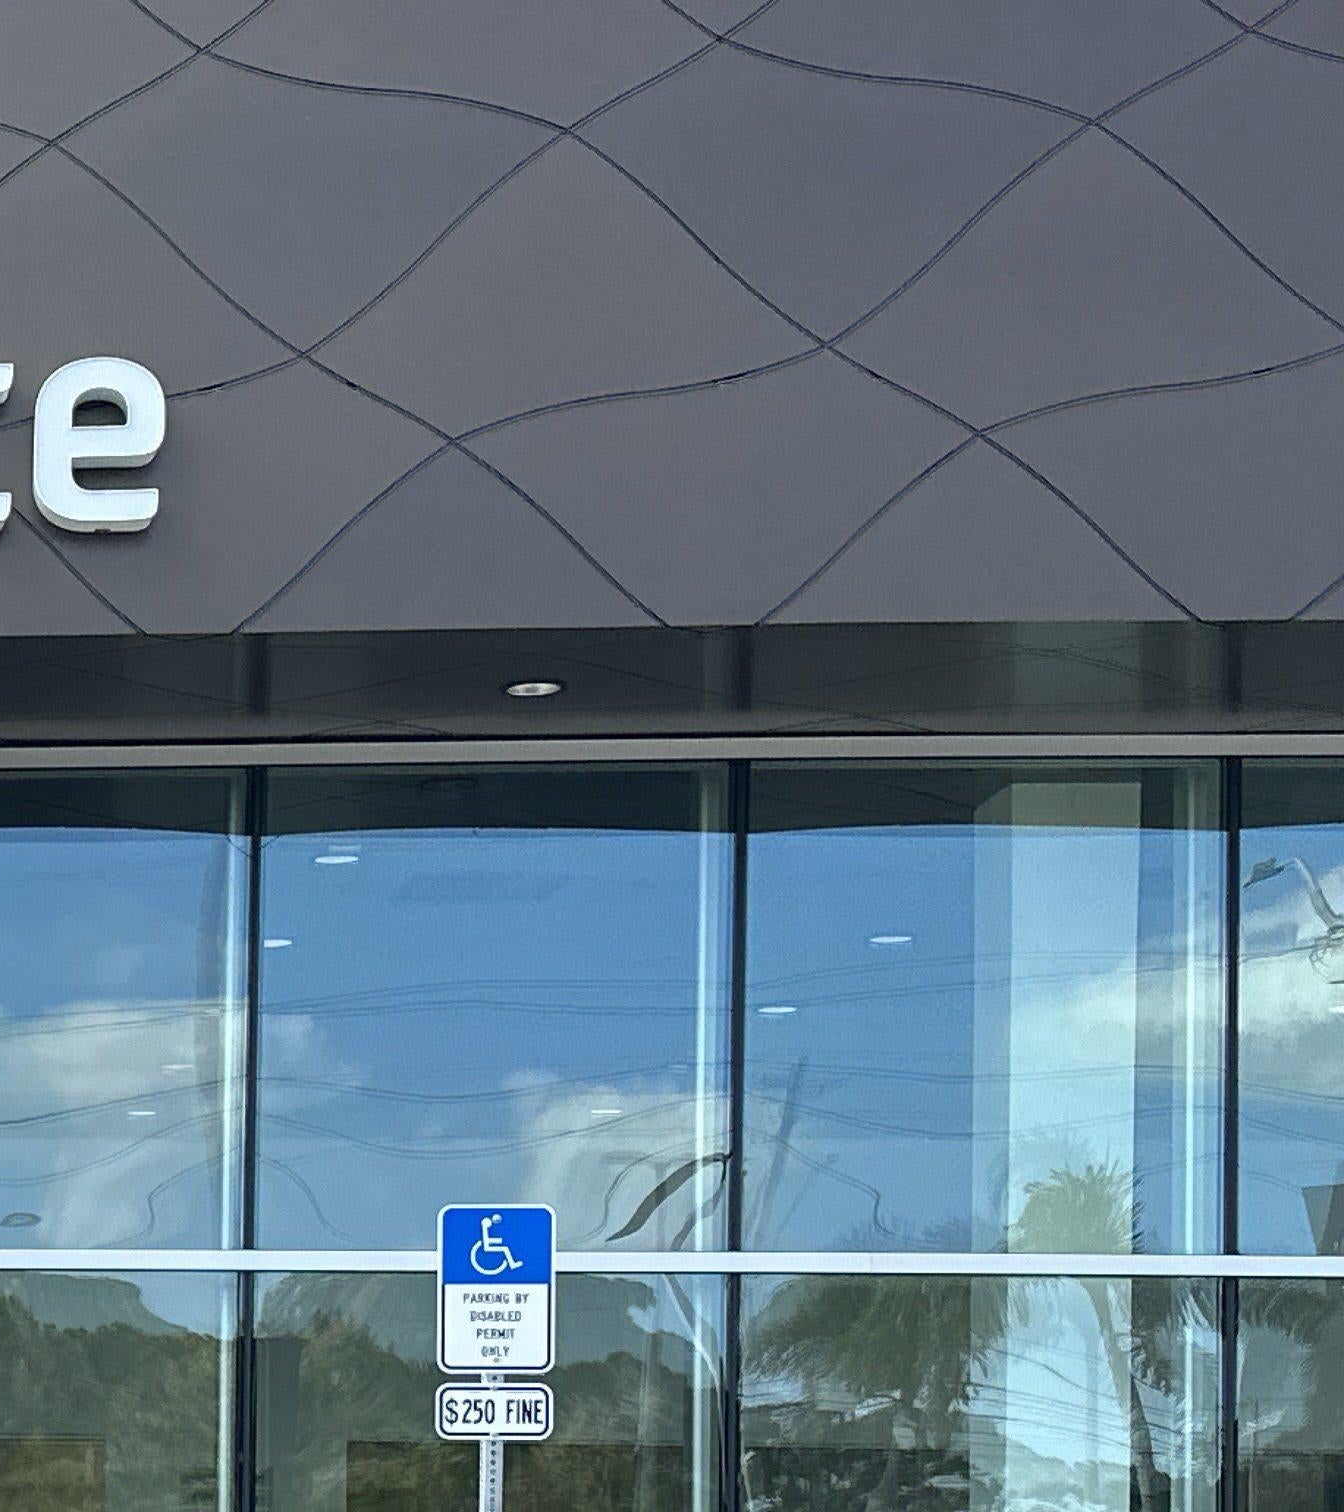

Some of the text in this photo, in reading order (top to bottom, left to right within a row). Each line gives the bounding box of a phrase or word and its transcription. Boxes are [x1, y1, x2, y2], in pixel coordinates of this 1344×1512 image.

[463, 1293, 529, 1304] PARKING BY
[470, 1311, 522, 1322] DISABLED
[476, 1328, 515, 1339] PERMIT
[445, 1398, 544, 1427] $250 FINE
